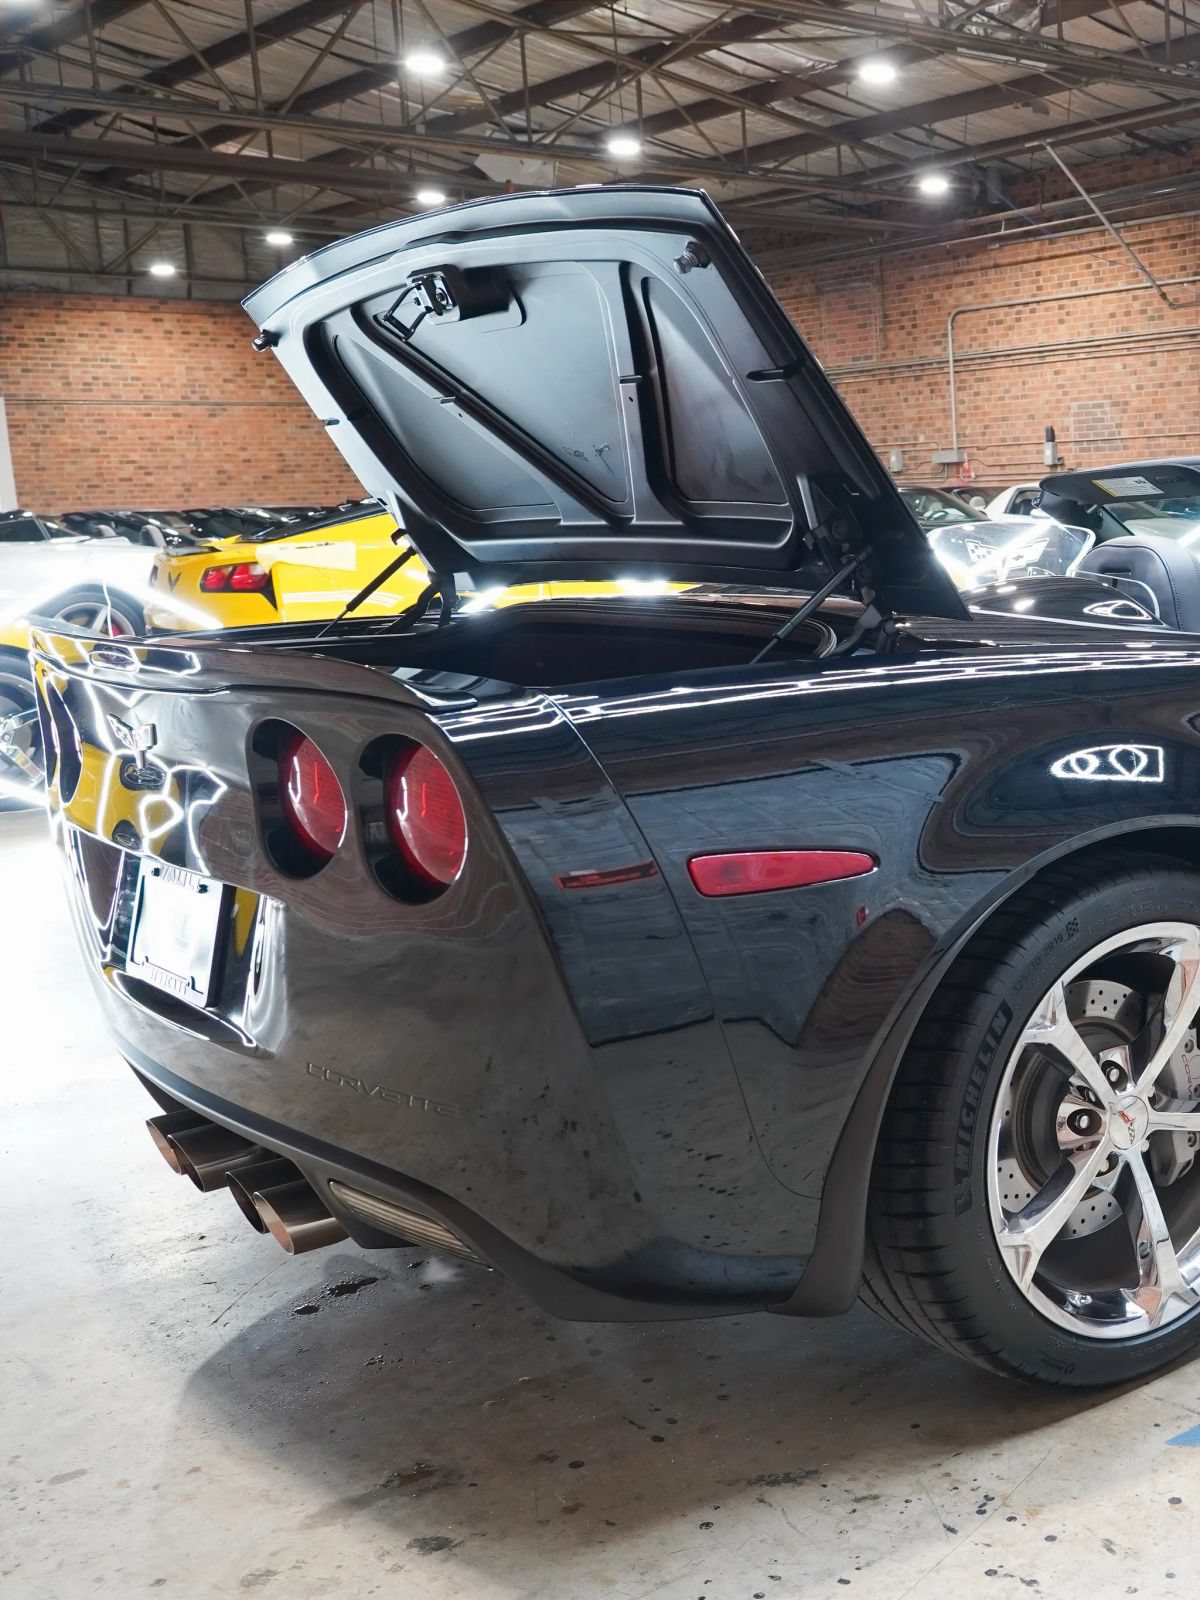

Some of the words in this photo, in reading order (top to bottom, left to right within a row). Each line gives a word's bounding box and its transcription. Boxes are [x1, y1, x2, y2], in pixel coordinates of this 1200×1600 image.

[306, 1062, 459, 1119] CORVETTE
[955, 1008, 1009, 1168] MICHELIN
[1181, 1054, 1193, 1100] CORV
